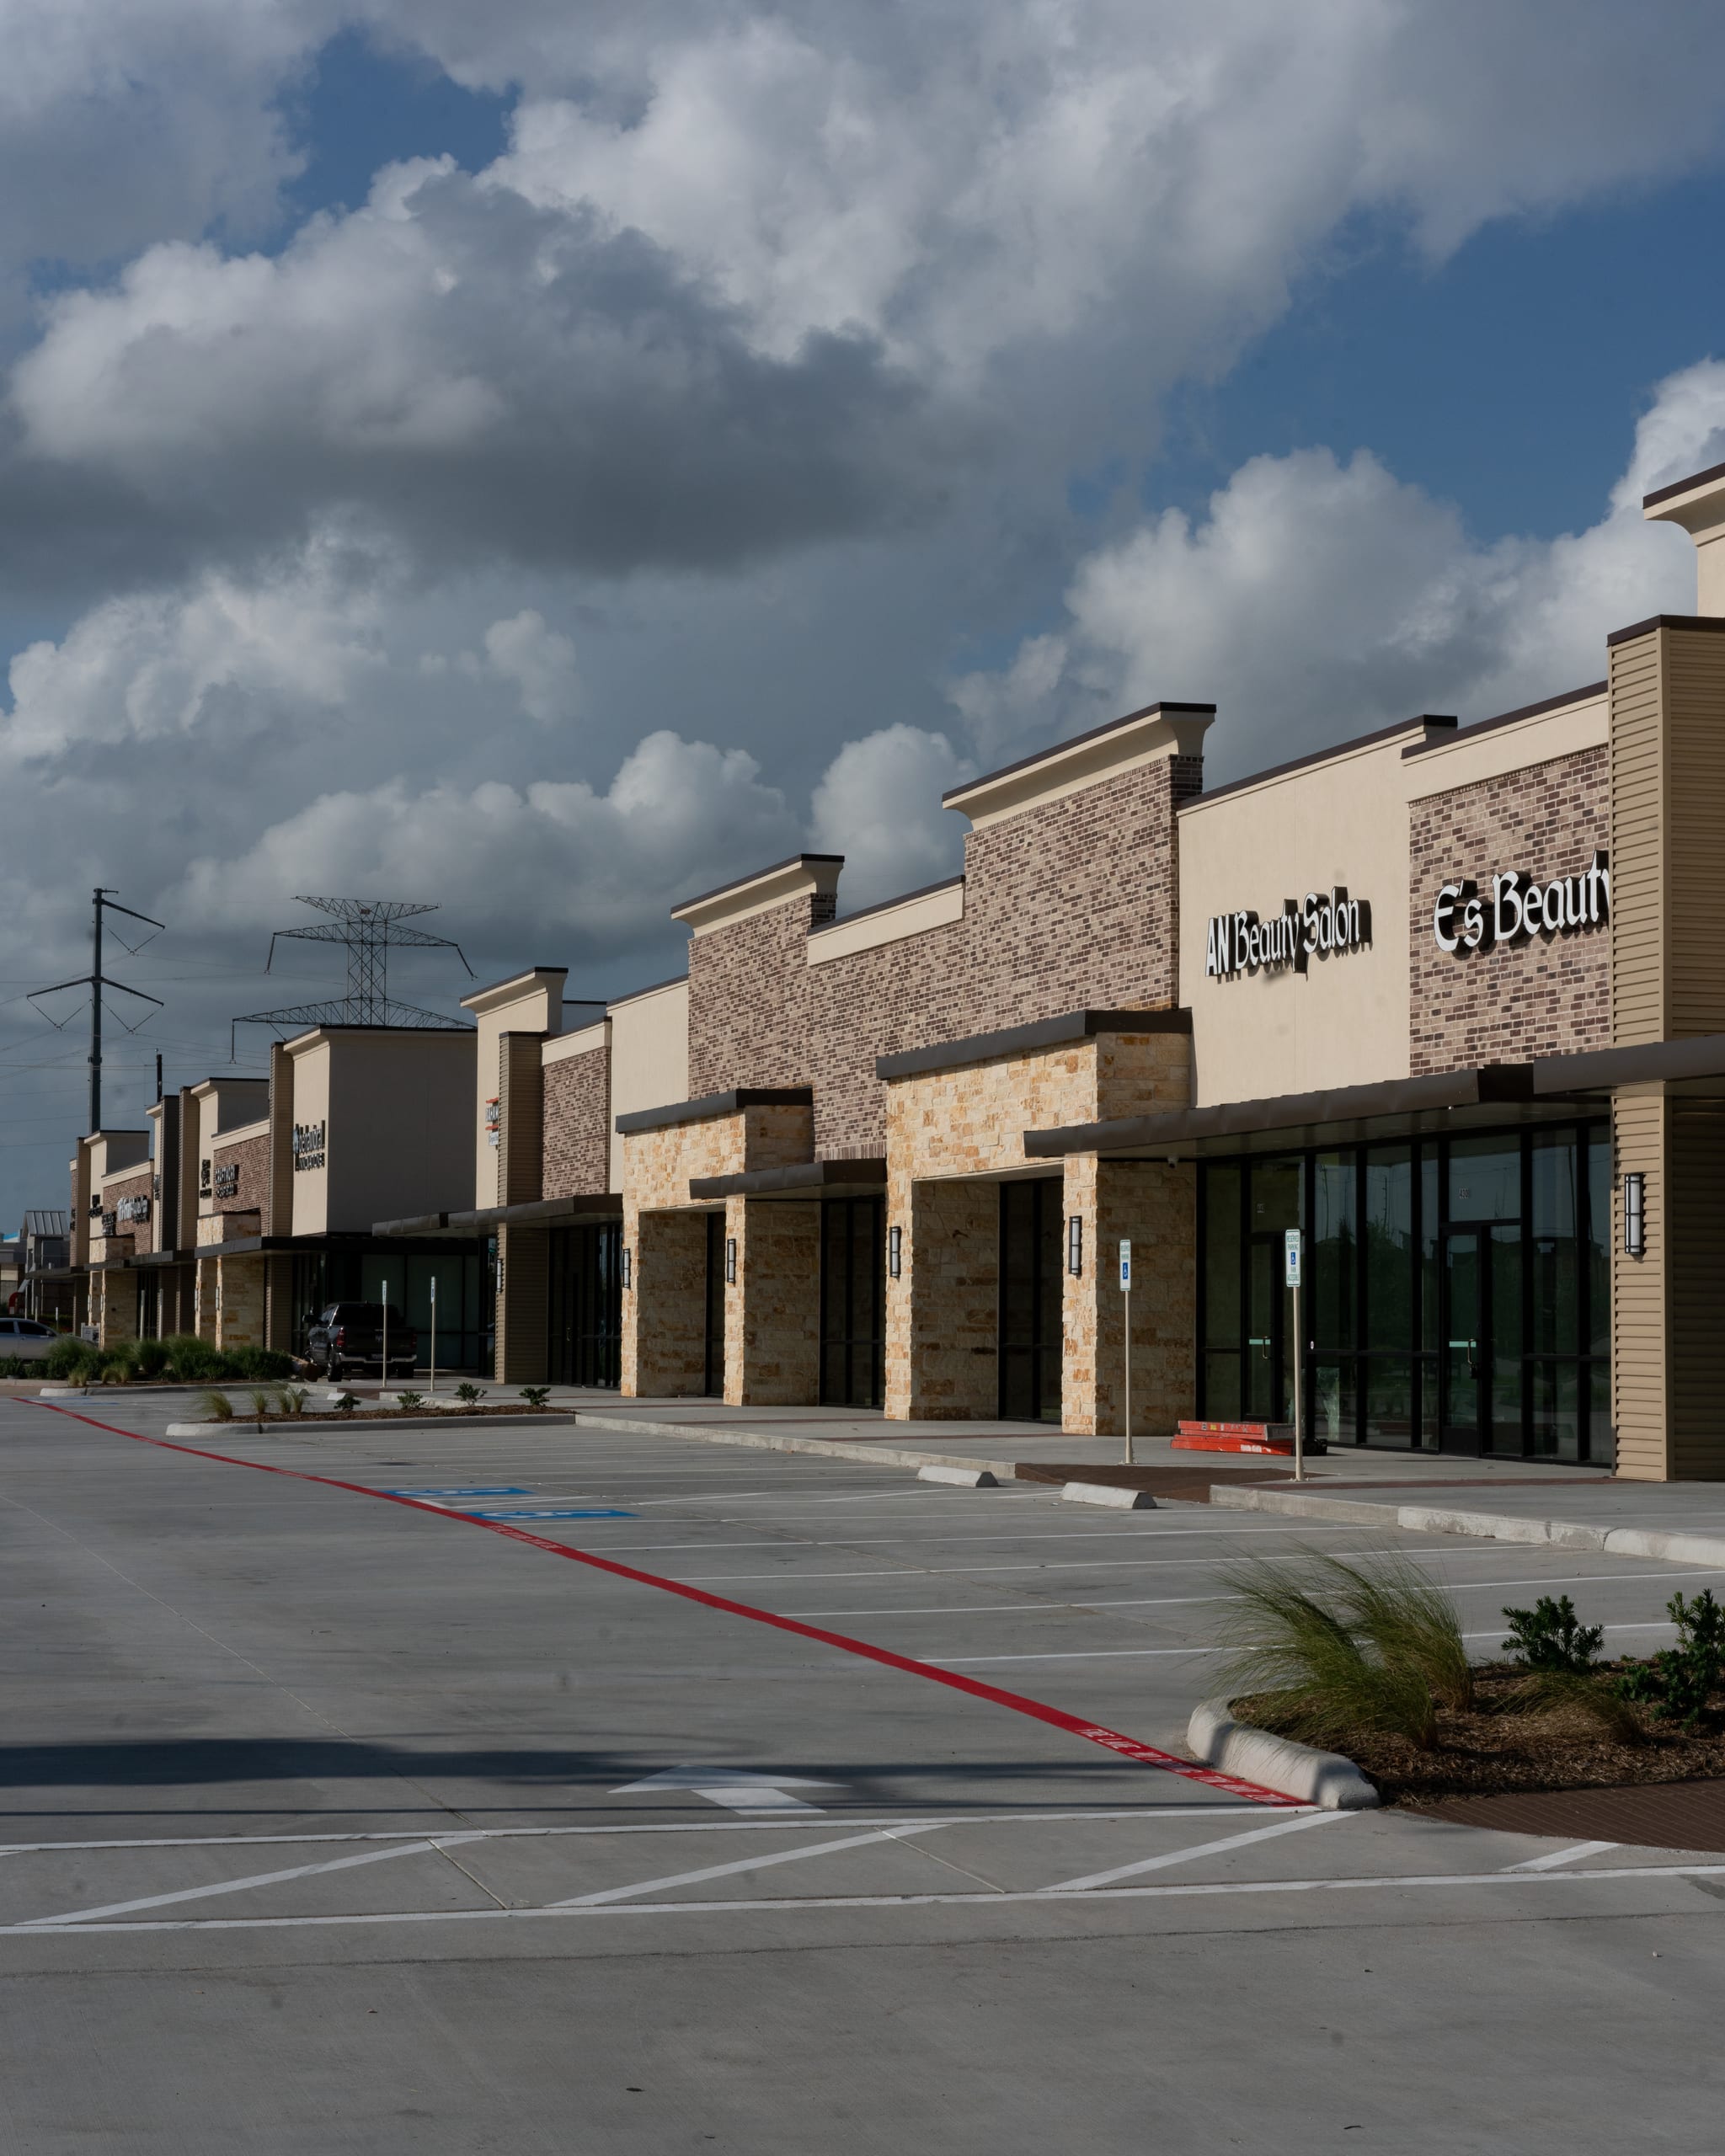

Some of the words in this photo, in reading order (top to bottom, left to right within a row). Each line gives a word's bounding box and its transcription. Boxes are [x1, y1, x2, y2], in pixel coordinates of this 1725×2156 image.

[1205, 914, 1231, 977] AN
[1234, 899, 1300, 974] Beauty
[1303, 886, 1362, 953] Salon
